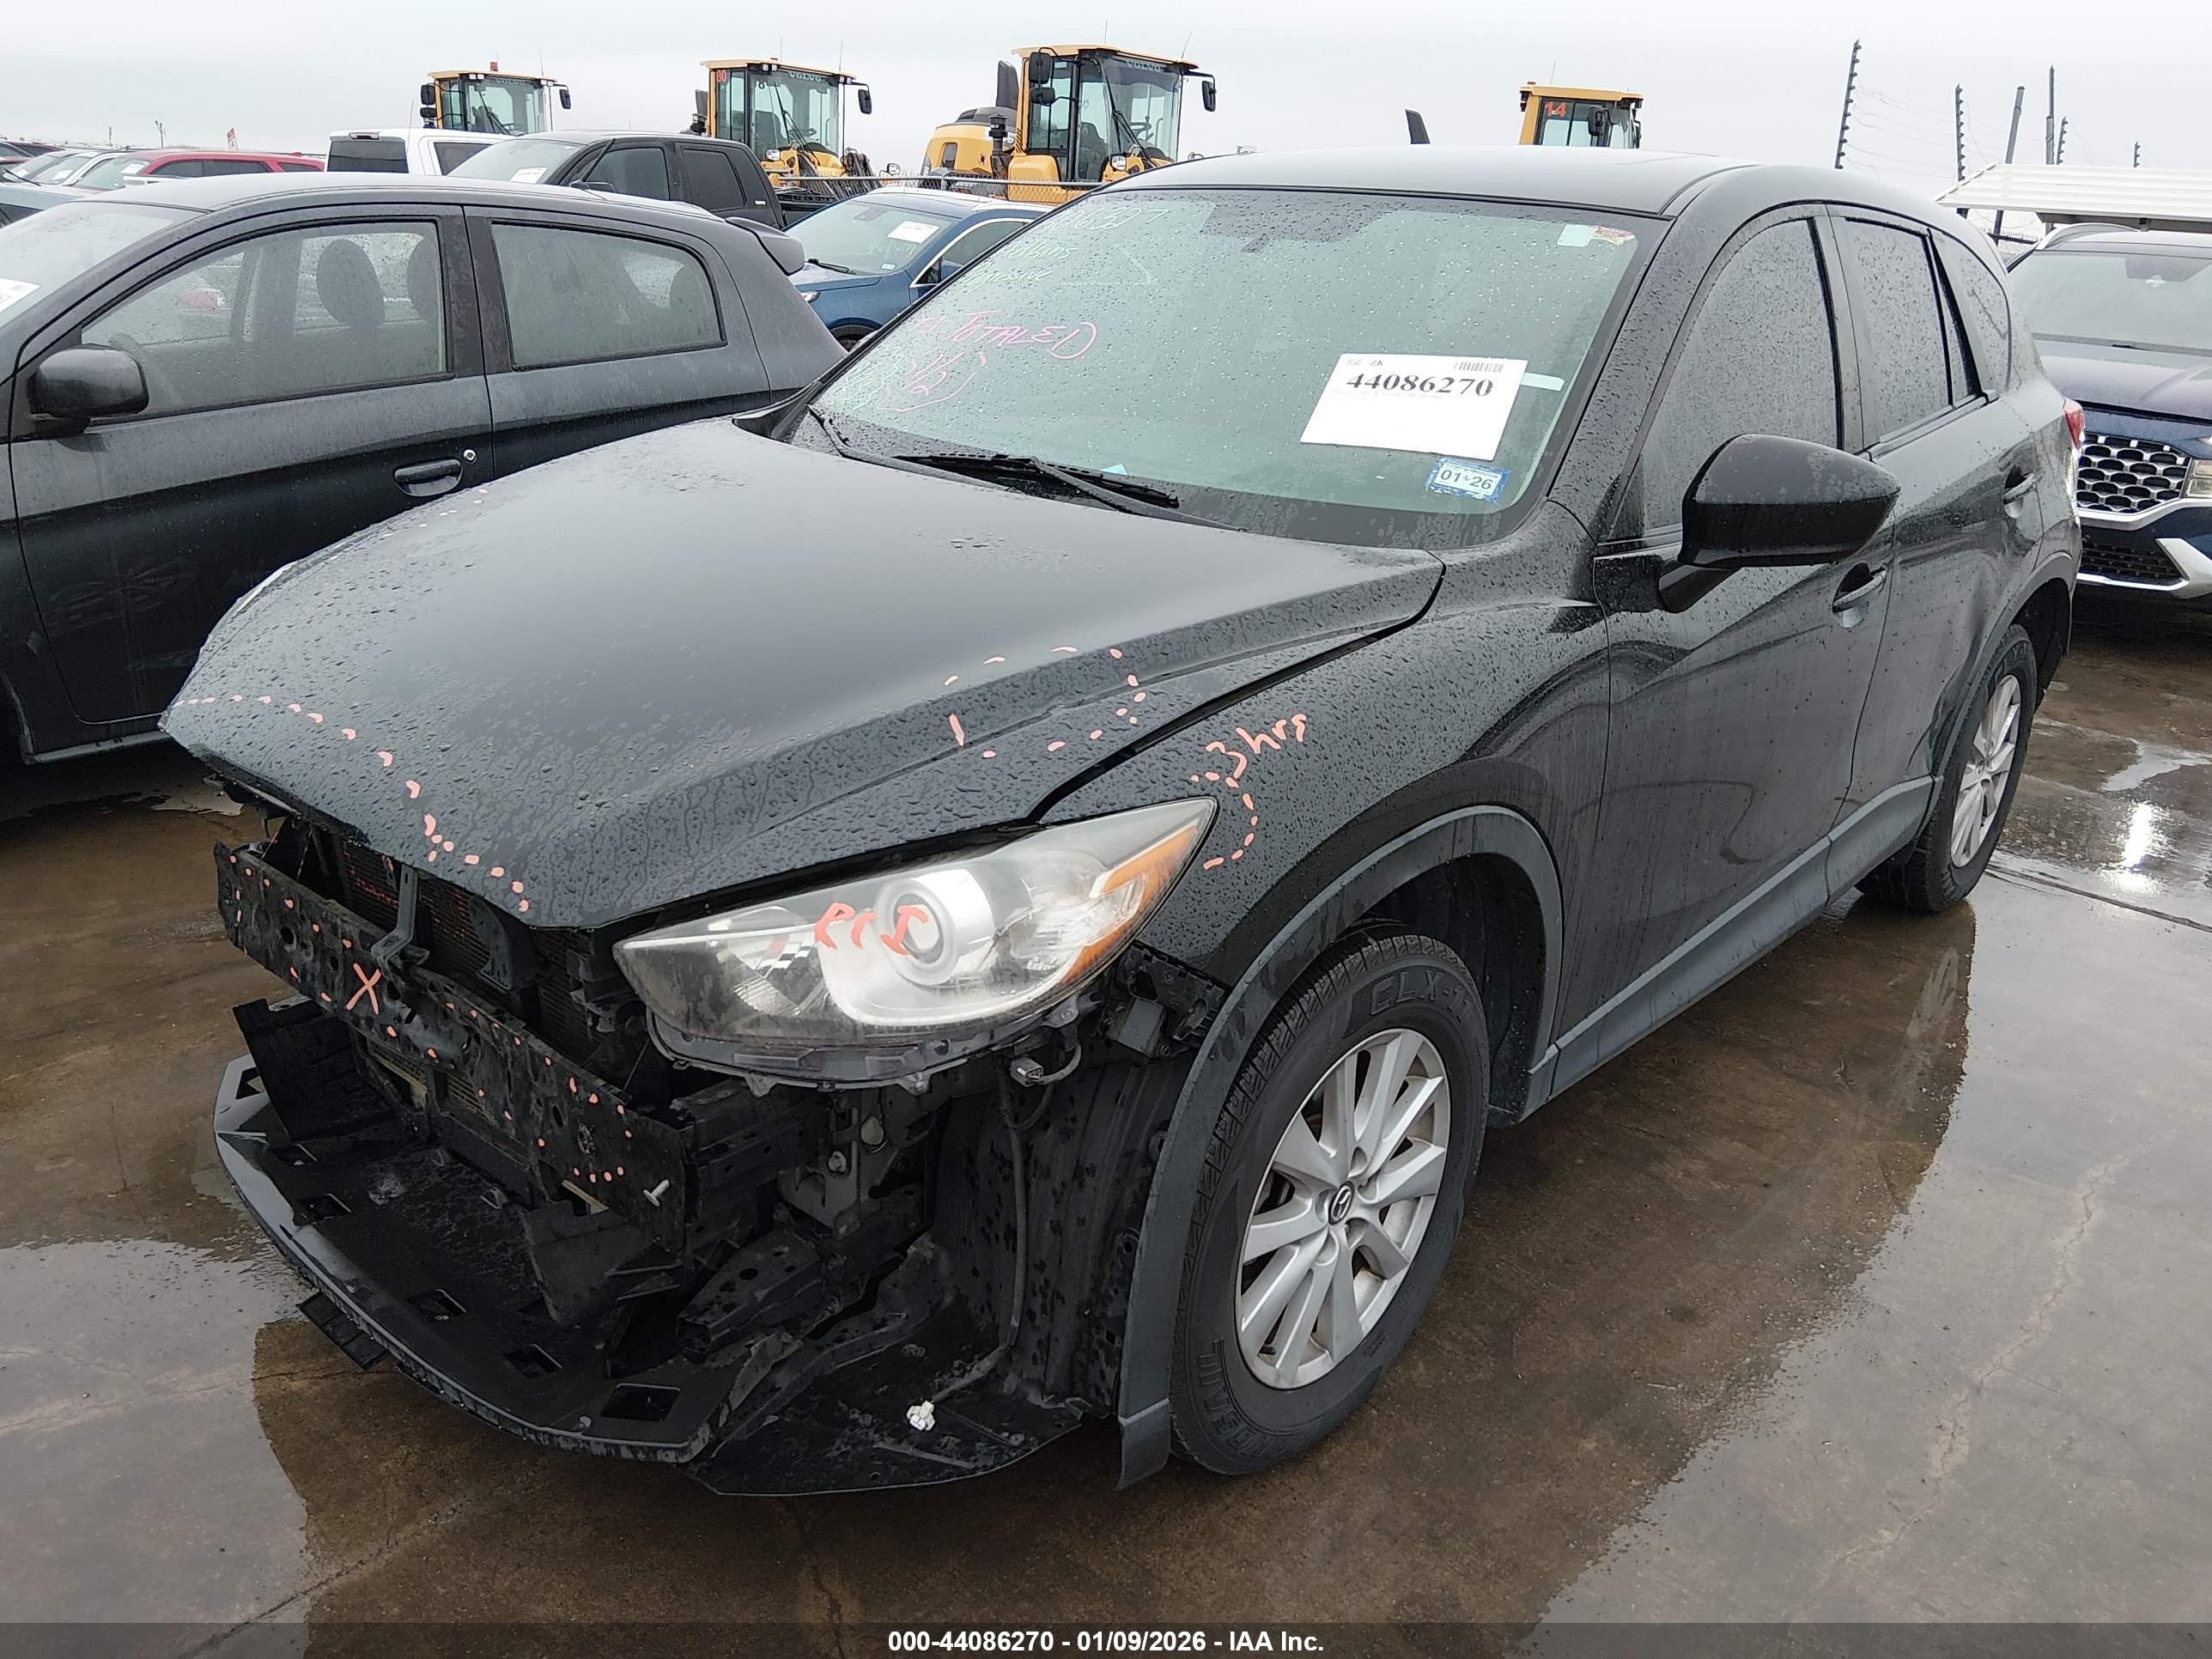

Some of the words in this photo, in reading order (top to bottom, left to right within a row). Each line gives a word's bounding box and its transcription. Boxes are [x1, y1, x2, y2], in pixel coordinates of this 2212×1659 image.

[1126, 60, 1162, 72] VOLVO
[715, 70, 728, 83] 80
[788, 71, 822, 82] VOLVO
[1545, 101, 1567, 118] 14
[1346, 373, 1494, 397] 44086270
